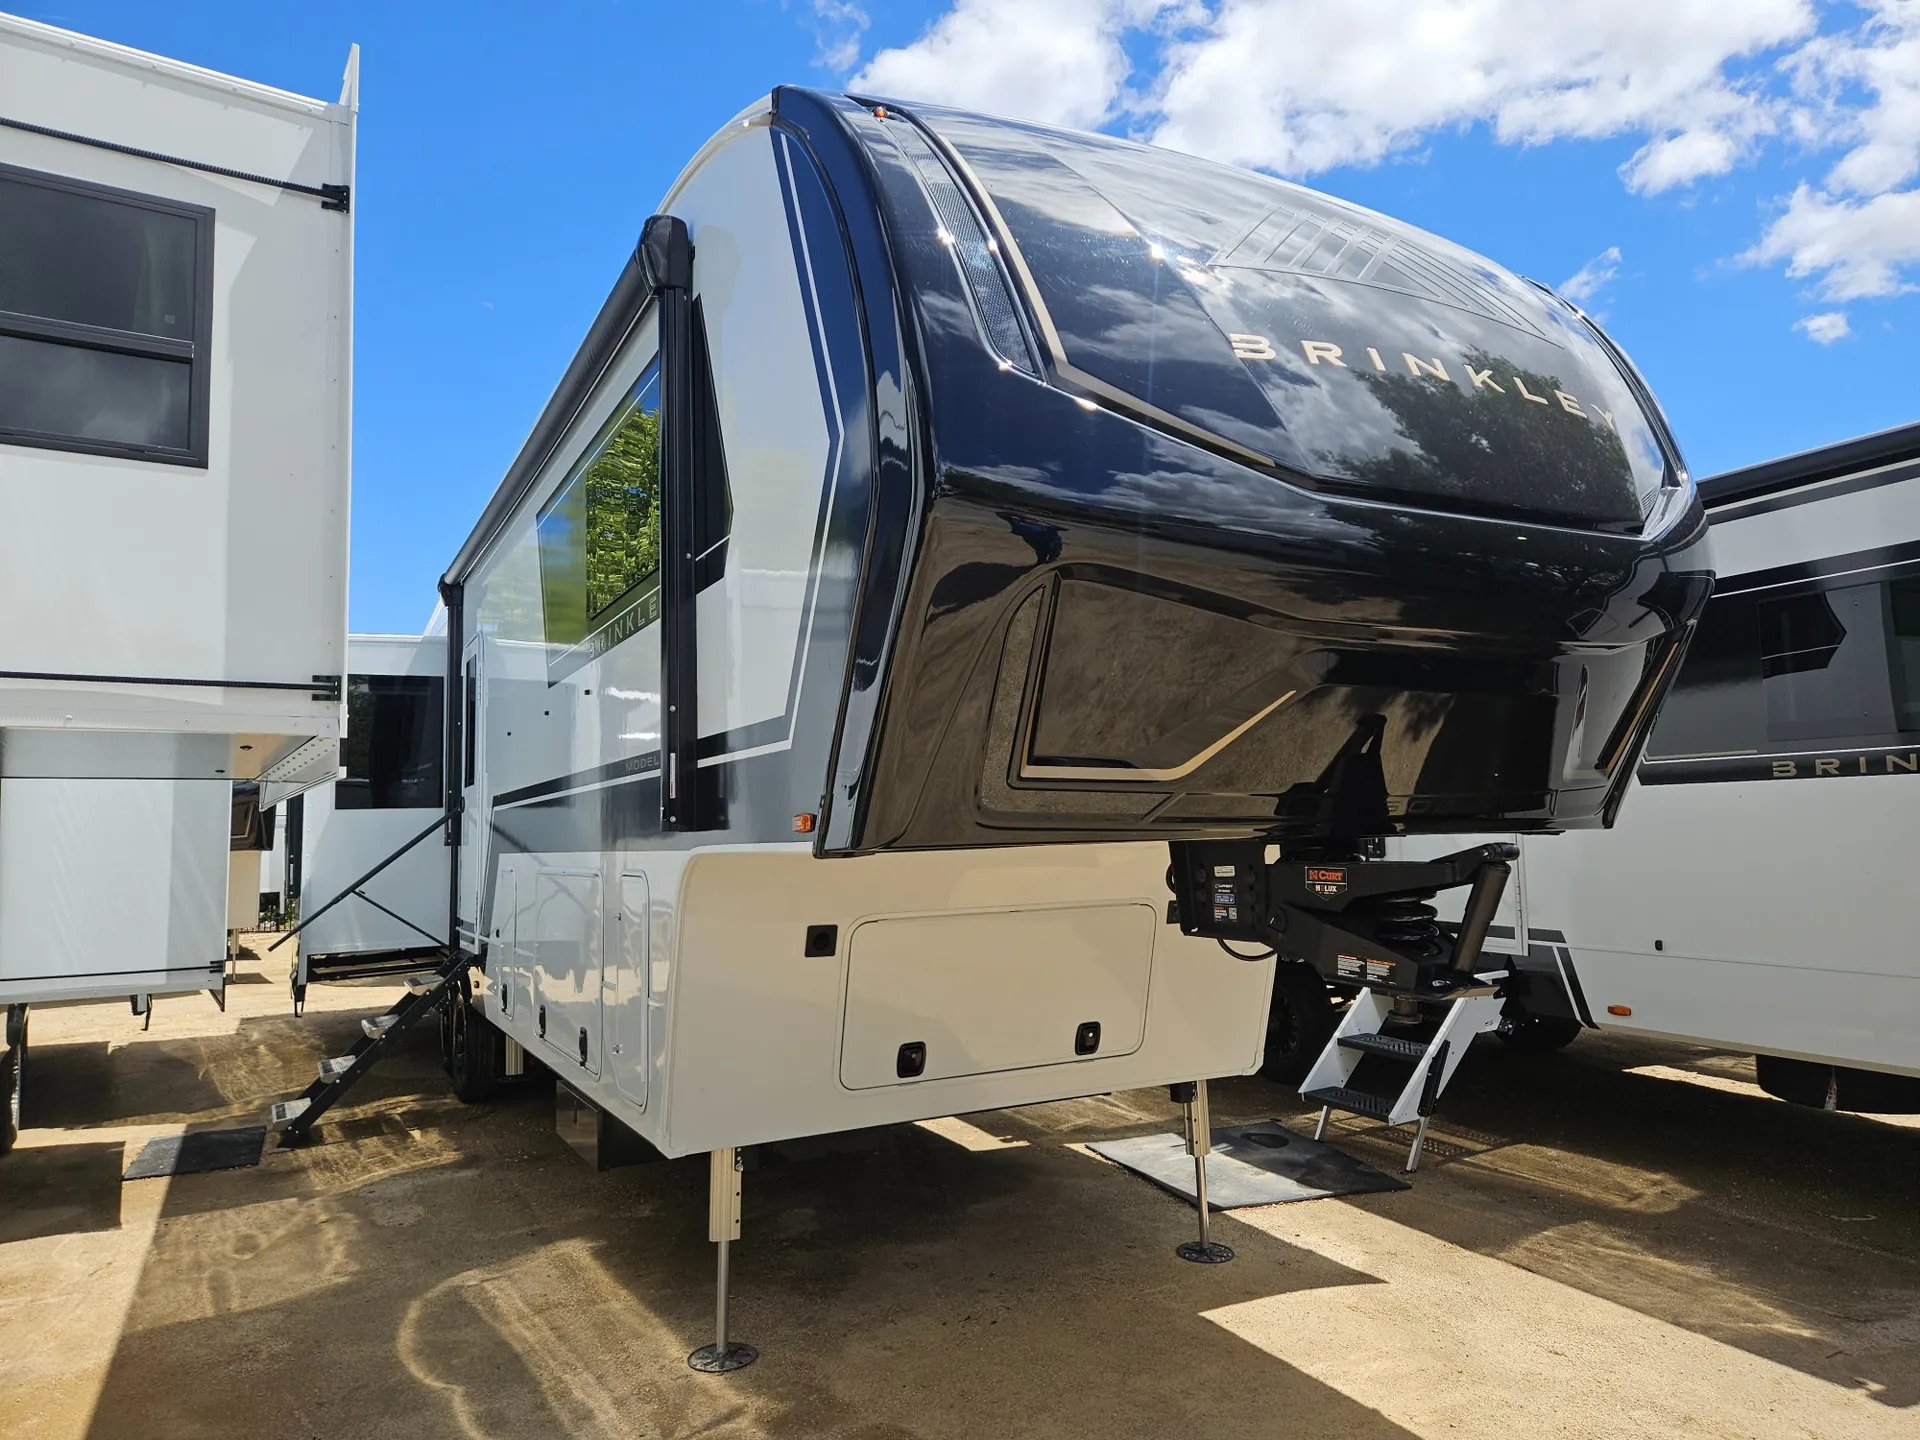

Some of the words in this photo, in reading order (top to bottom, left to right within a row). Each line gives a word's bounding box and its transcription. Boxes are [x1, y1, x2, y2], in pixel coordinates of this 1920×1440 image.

[1229, 333, 1616, 430] BRINKLEY
[625, 755, 660, 773] MODEL
[1772, 753, 1918, 777] BRIN
[1319, 870, 1343, 881] CURT
